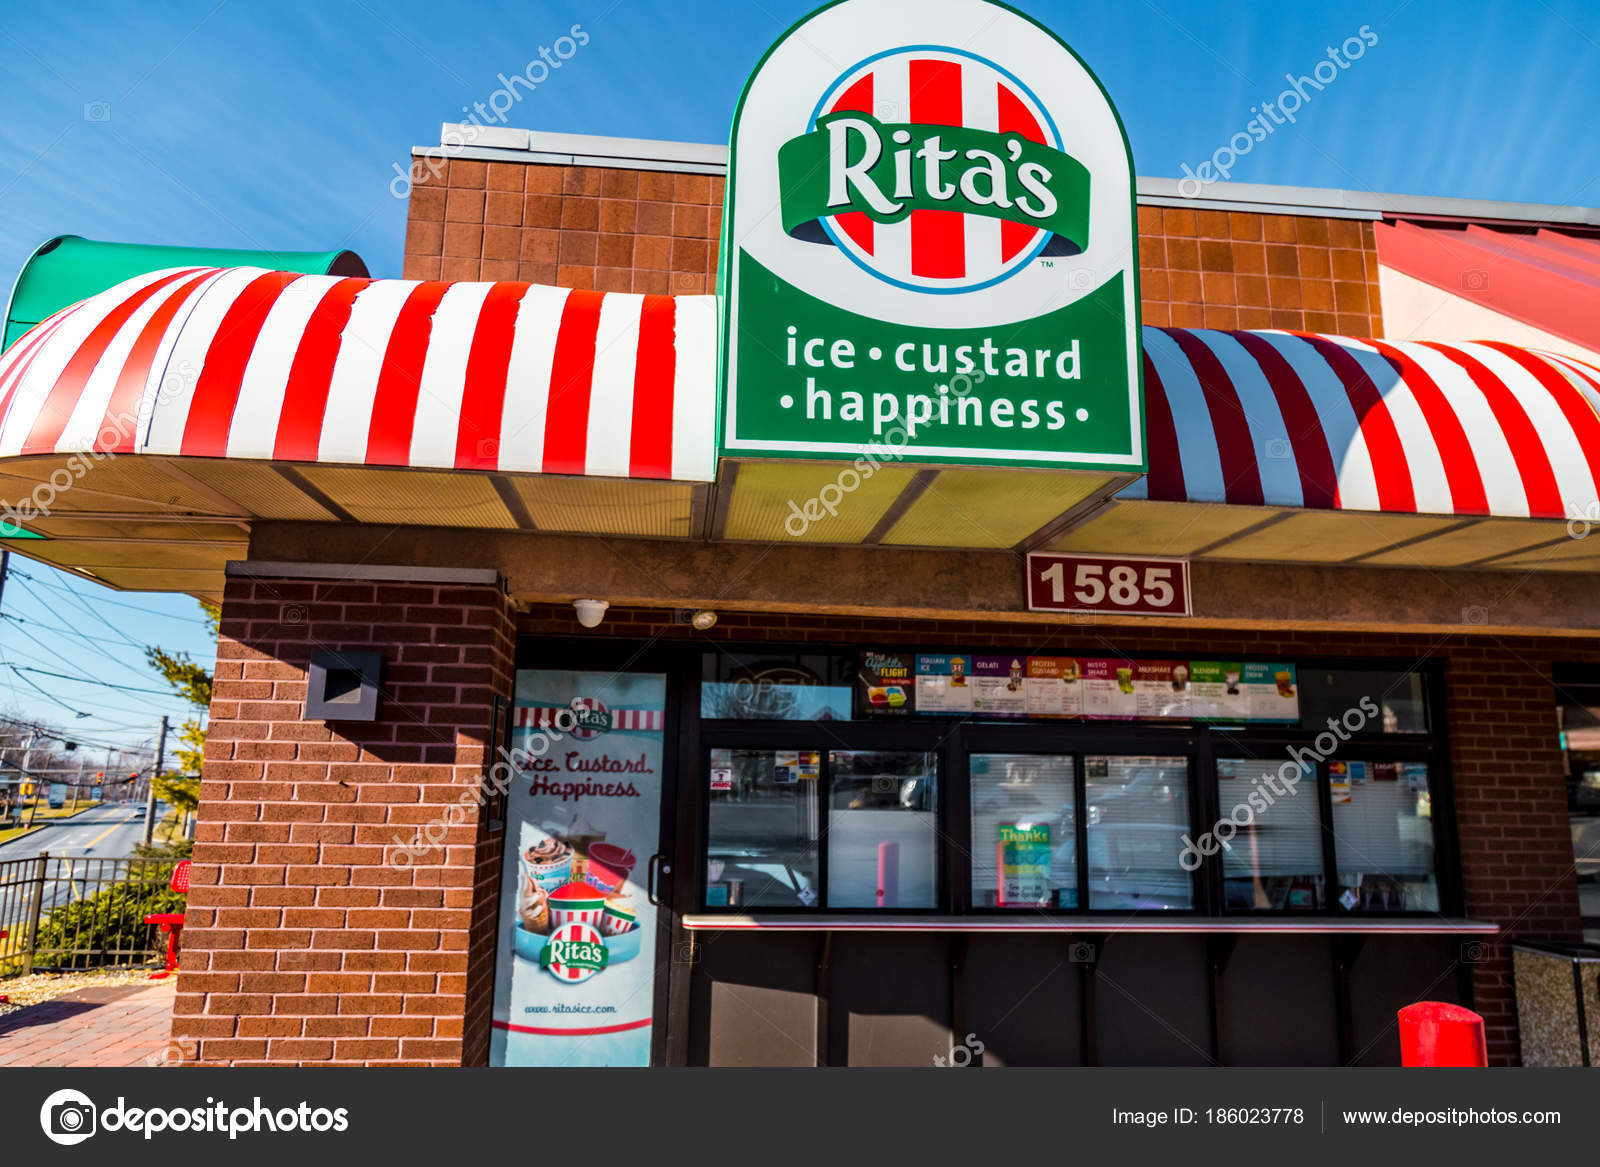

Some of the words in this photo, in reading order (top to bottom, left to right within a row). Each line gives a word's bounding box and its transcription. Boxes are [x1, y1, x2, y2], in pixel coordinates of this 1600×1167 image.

[826, 117, 1059, 219] Rita's
[786, 325, 856, 369] ice
[894, 337, 1082, 380] custard
[805, 377, 1066, 437] happiness
[1041, 562, 1175, 608] 1585
[880, 668, 908, 678] FLIGHT
[920, 657, 945, 665] ITALIAN
[976, 661, 999, 669] GELATI
[565, 750, 654, 774] Custard.
[528, 774, 641, 802] Happiness.
[1000, 828, 1048, 842] Thanks
[550, 939, 602, 964] Rita's
